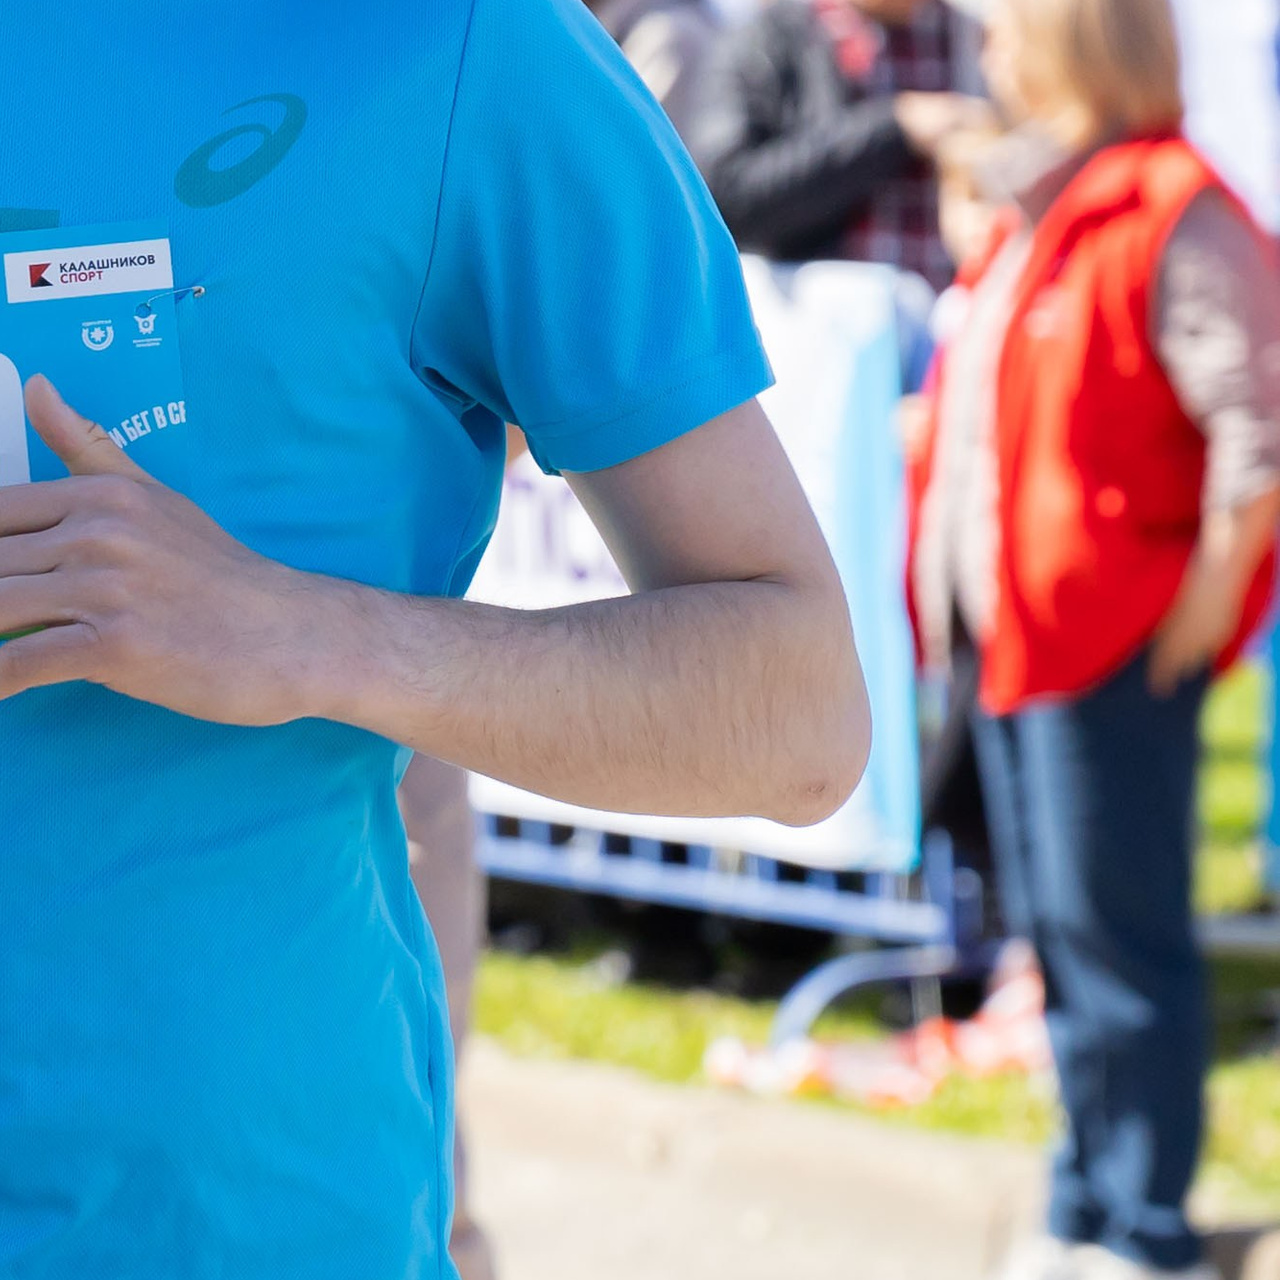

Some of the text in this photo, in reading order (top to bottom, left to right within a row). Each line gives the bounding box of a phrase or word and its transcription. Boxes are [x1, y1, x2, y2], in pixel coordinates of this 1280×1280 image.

[59, 254, 156, 274] КАЛАШНИКОВ
[60, 270, 104, 284] СПОРТ
[120, 410, 152, 442] БЕГ
